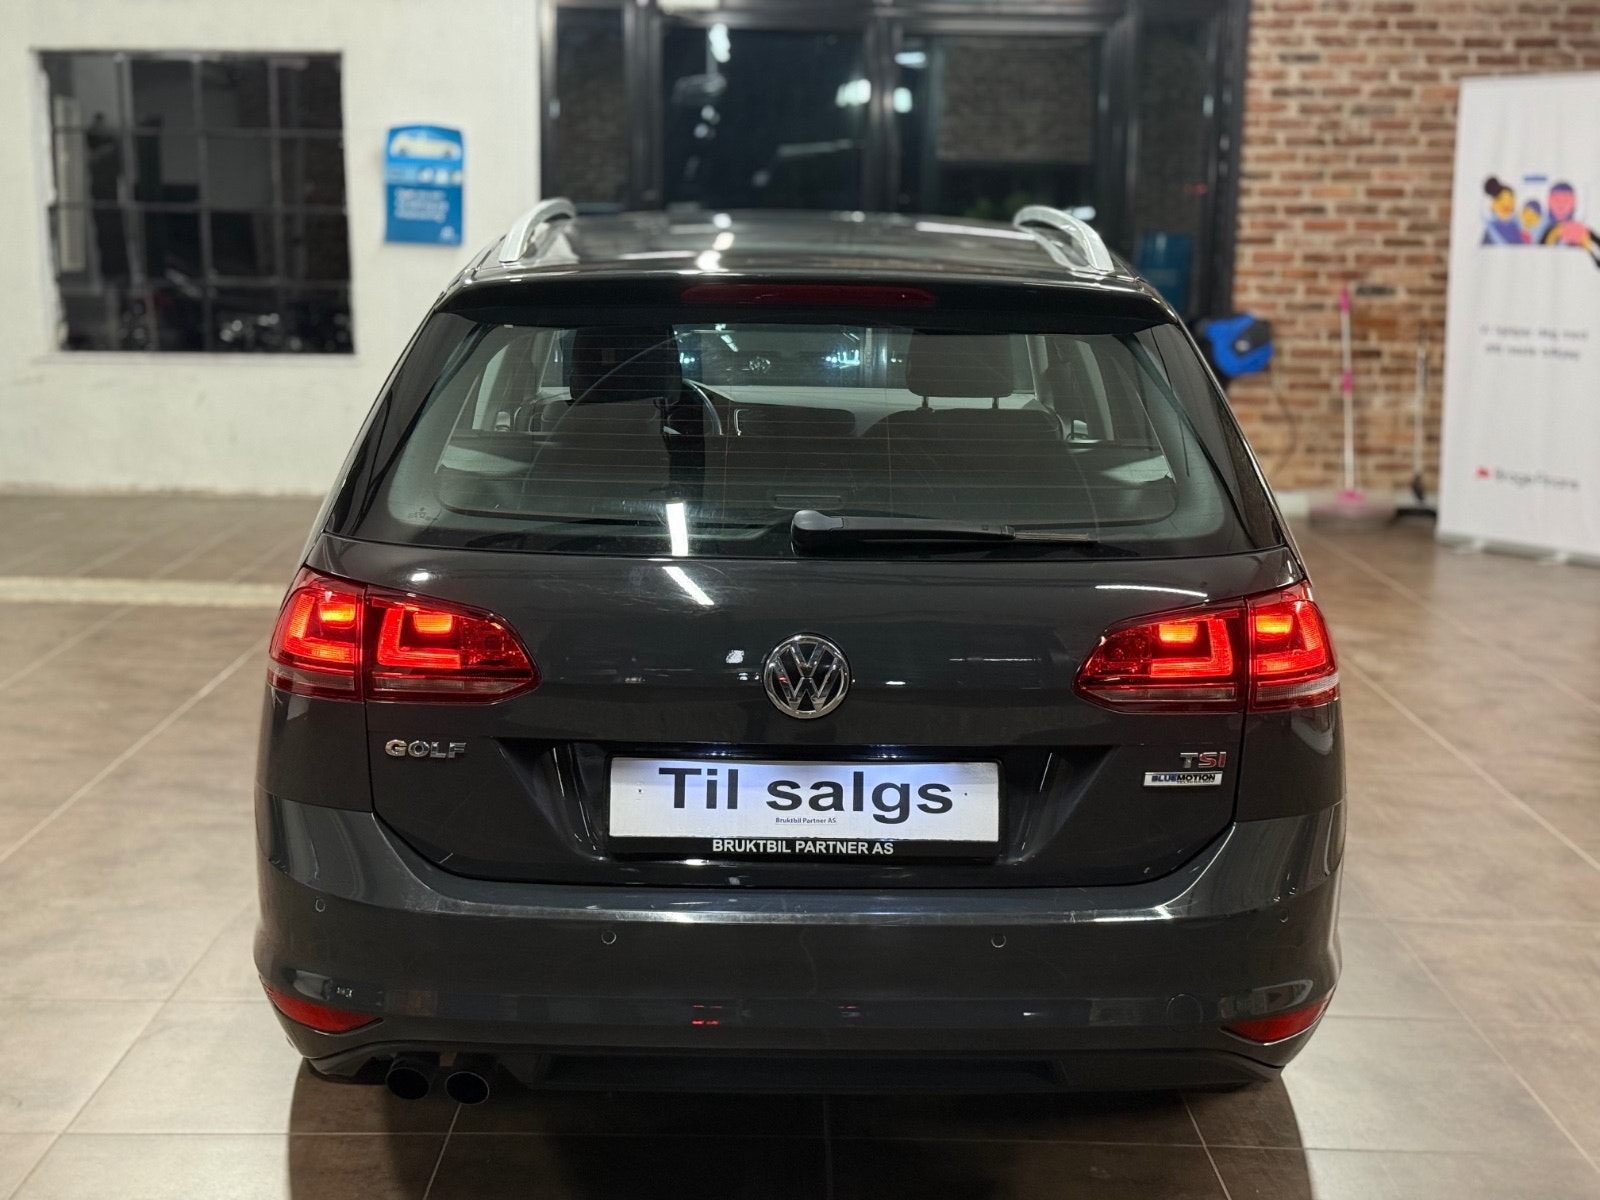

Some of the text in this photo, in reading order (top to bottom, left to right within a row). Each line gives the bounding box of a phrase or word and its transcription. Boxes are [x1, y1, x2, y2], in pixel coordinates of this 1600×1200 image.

[385, 739, 467, 758] GOLF
[1180, 752, 1227, 769] TSI
[1151, 773, 1216, 782] BLUEMOTION
[658, 767, 954, 824] Til salgs
[775, 816, 802, 824] Bruktbil
[712, 839, 894, 855] BRUKTBIL PARTNER AS
